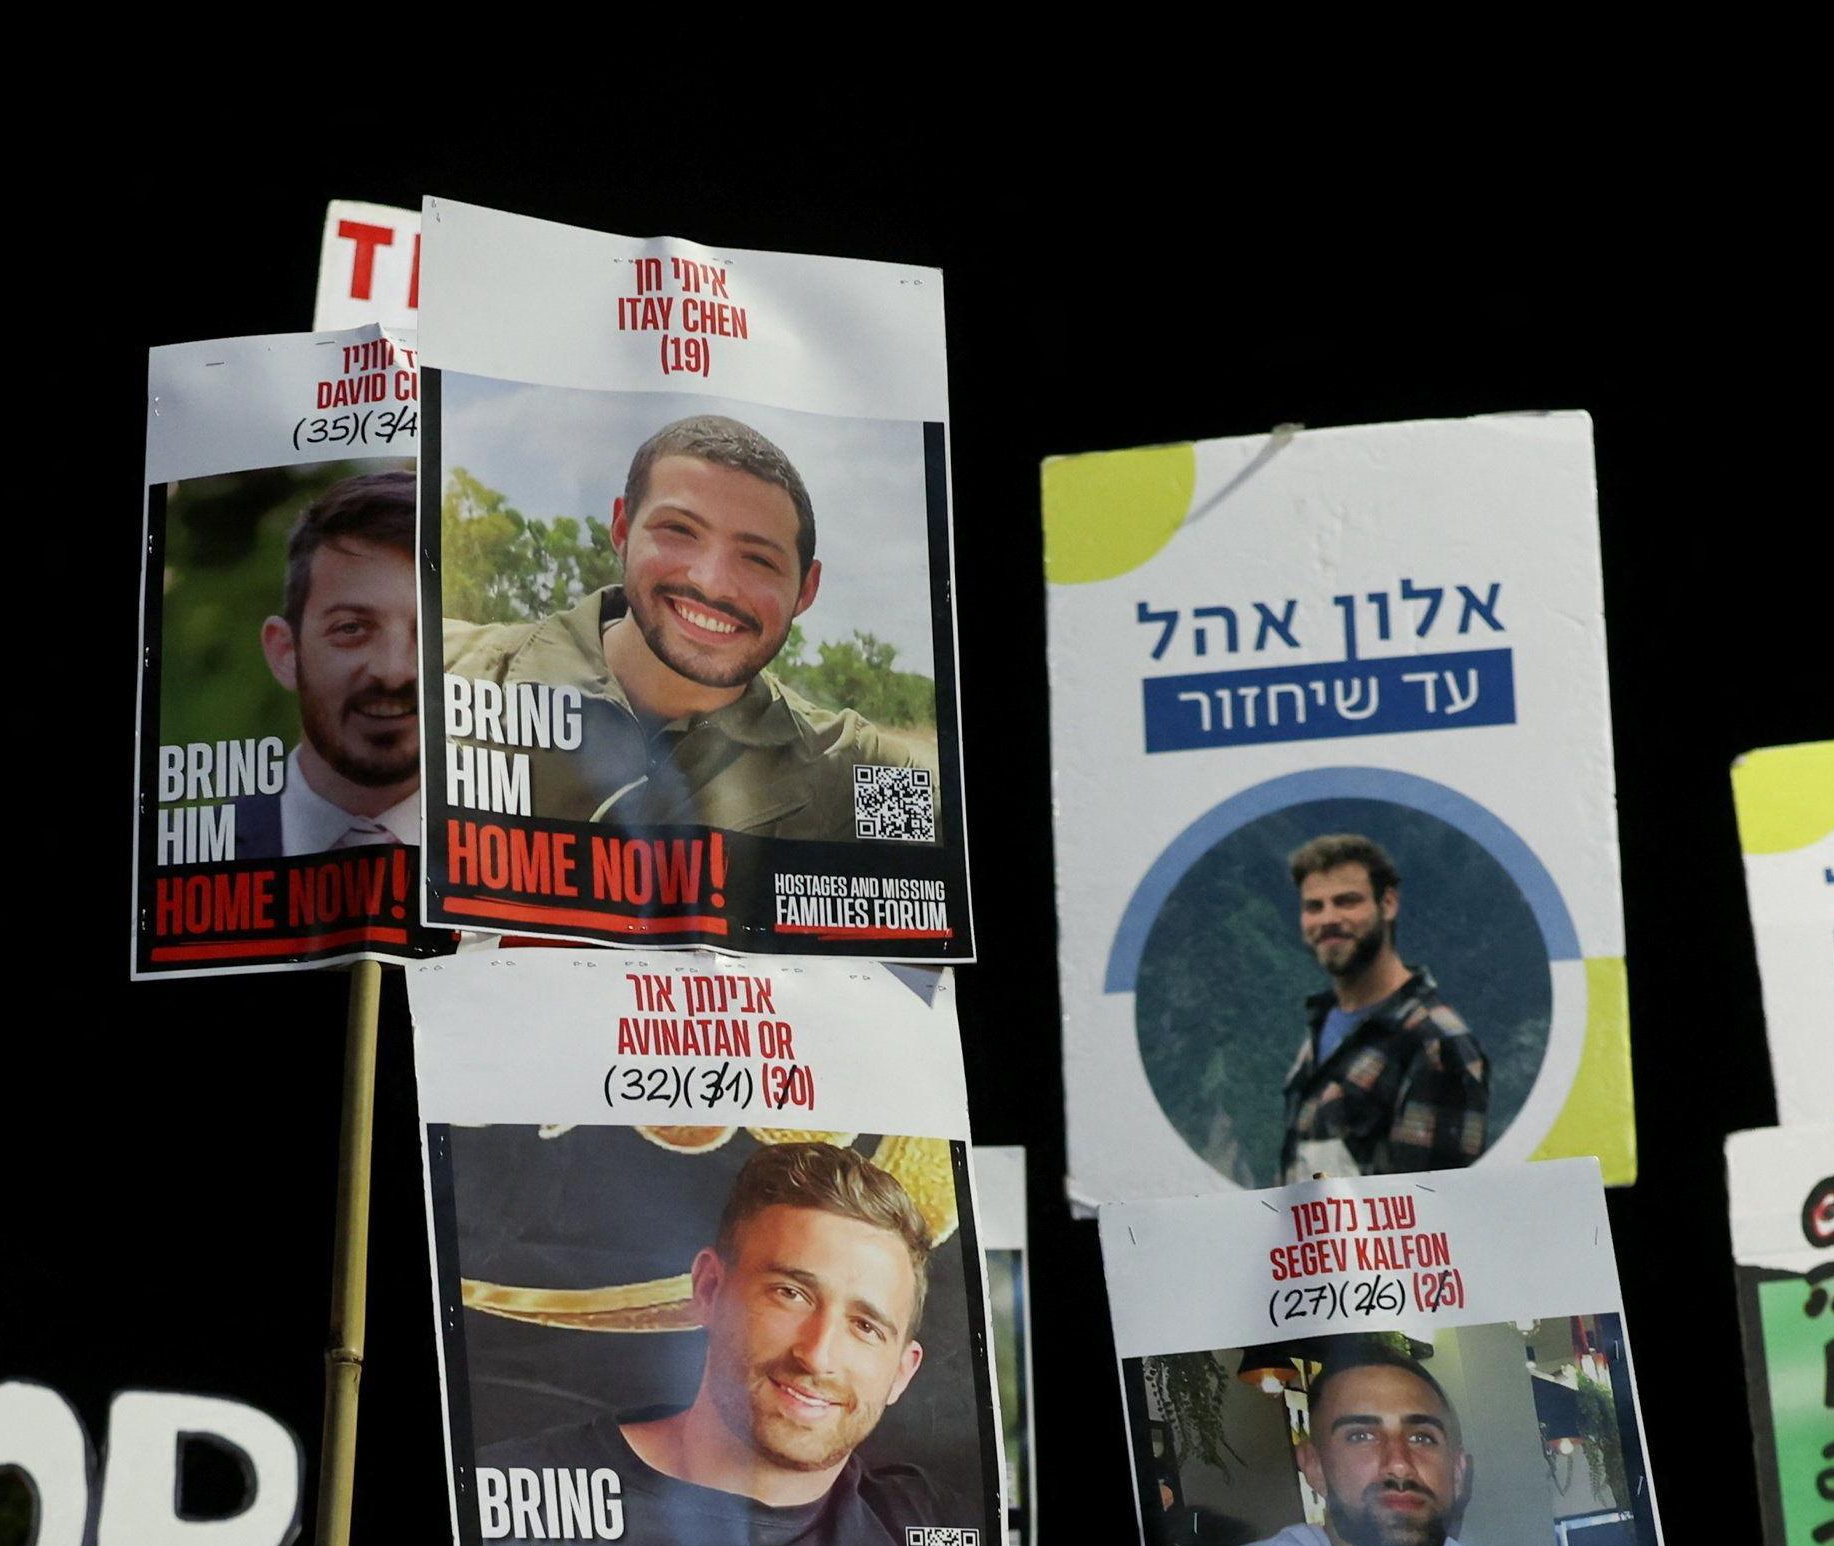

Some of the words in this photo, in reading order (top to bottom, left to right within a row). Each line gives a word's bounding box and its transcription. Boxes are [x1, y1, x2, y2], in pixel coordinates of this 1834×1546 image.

[634, 257, 663, 295] חן
[670, 257, 727, 299] איתי
[618, 297, 671, 332] ITAY
[682, 301, 748, 340] CHEN
[660, 334, 710, 378] (19)
[316, 371, 387, 411] DAVID
[1137, 600, 1301, 662] אהל
[1334, 578, 1507, 663] אלון
[443, 672, 584, 751] BRING
[1178, 676, 1381, 732] שיחזור
[1402, 668, 1480, 716] עד
[158, 735, 285, 803] BRING
[444, 741, 532, 817] HIM
[158, 804, 237, 868] HIM
[446, 818, 578, 900] HOME
[592, 831, 728, 910] NOW!
[774, 873, 849, 898] HOSTAGES
[851, 875, 878, 898] AND
[880, 876, 946, 902] MISSING
[155, 872, 280, 939] HOME
[288, 846, 410, 931] NOW!
[774, 894, 870, 930] FAMILIES
[872, 897, 948, 932] FORUM
[626, 973, 673, 1013] אור
[684, 973, 773, 1017] אבינתן
[617, 1018, 753, 1059] AVINATAN
[758, 1021, 796, 1060] OR
[1291, 1197, 1359, 1243] כלפון
[1364, 1195, 1416, 1233] שגב
[1270, 1239, 1349, 1284] SEGEV
[1355, 1232, 1452, 1275] KALFON
[475, 1467, 625, 1541] BRING
